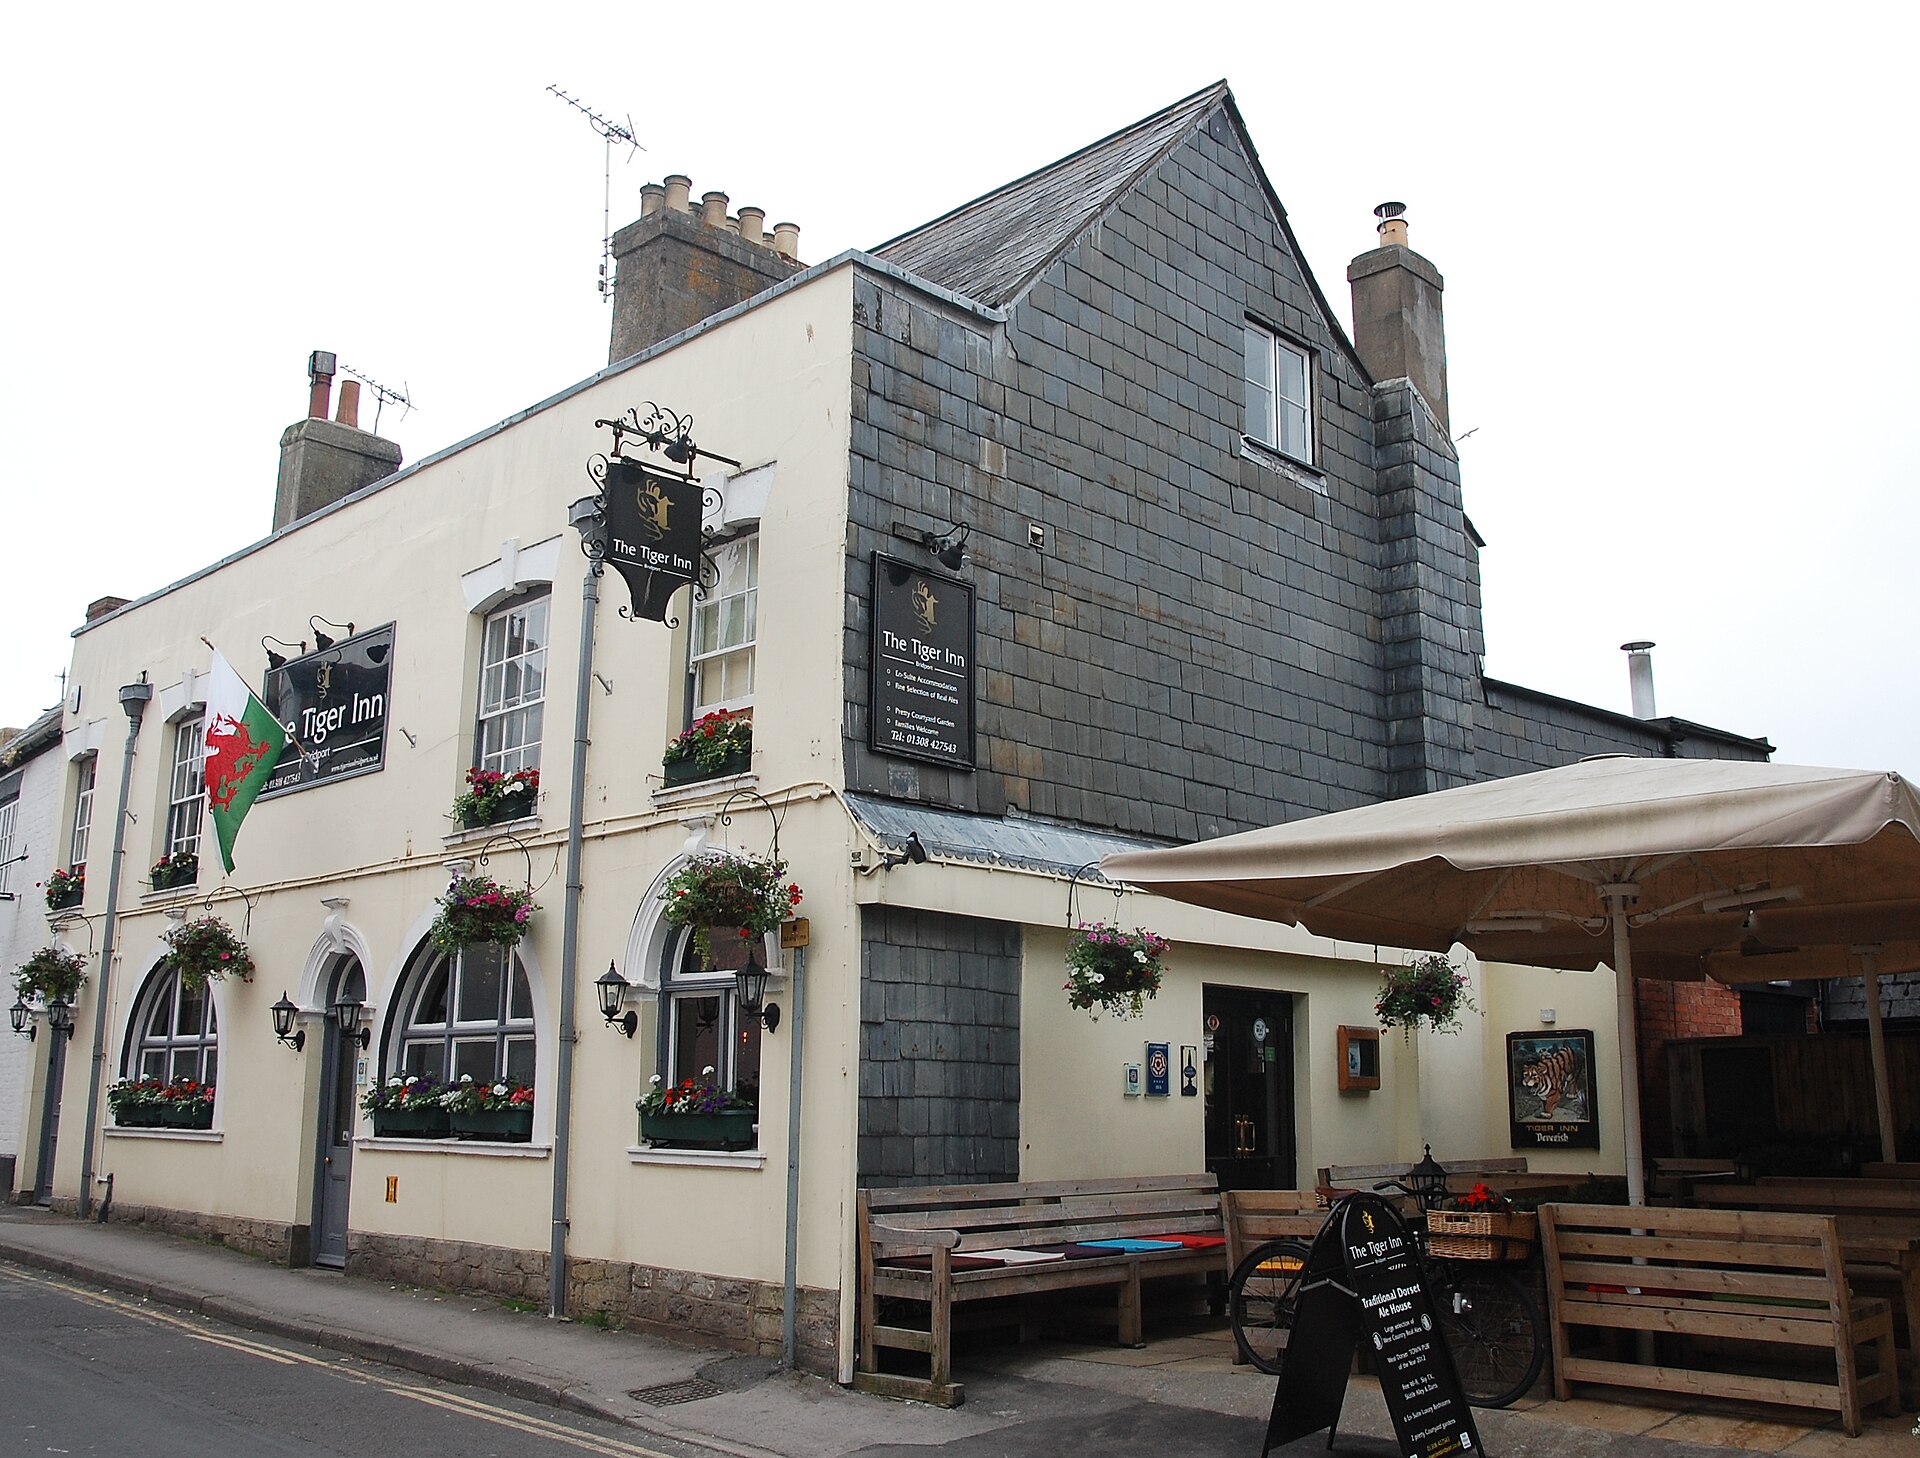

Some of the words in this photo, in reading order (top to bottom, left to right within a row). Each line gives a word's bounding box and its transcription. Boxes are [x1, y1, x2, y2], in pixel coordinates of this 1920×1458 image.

[613, 538, 637, 556] The
[640, 545, 670, 565] Tiger
[674, 553, 692, 570] Inn
[883, 630, 907, 651] The
[911, 638, 941, 662] Tiger
[946, 648, 965, 667] Inn
[916, 661, 933, 671] Bridport
[895, 682, 906, 691] Fine
[907, 685, 929, 697] Selection
[937, 693, 948, 701] Real
[948, 695, 959, 704] Ales
[917, 676, 957, 692] Accommodation
[303, 707, 347, 744] Tiger
[352, 693, 383, 724] Inn
[895, 707, 910, 718] Pretty
[911, 711, 936, 723] Courtyard
[937, 718, 955, 728] Garden
[895, 720, 915, 730] Families
[916, 724, 939, 736] Welcome
[891, 730, 905, 742] Tel:
[907, 734, 930, 747] 01308
[930, 740, 957, 753] 427543
[1349, 1245, 1368, 1260] The
[1367, 1241, 1388, 1257] Tiger
[1388, 1236, 1403, 1249] Inn
[1361, 1288, 1397, 1310] Traditional
[1397, 1283, 1421, 1299] Dorset
[1378, 1306, 1390, 1319] Ale
[1389, 1300, 1413, 1315] House
